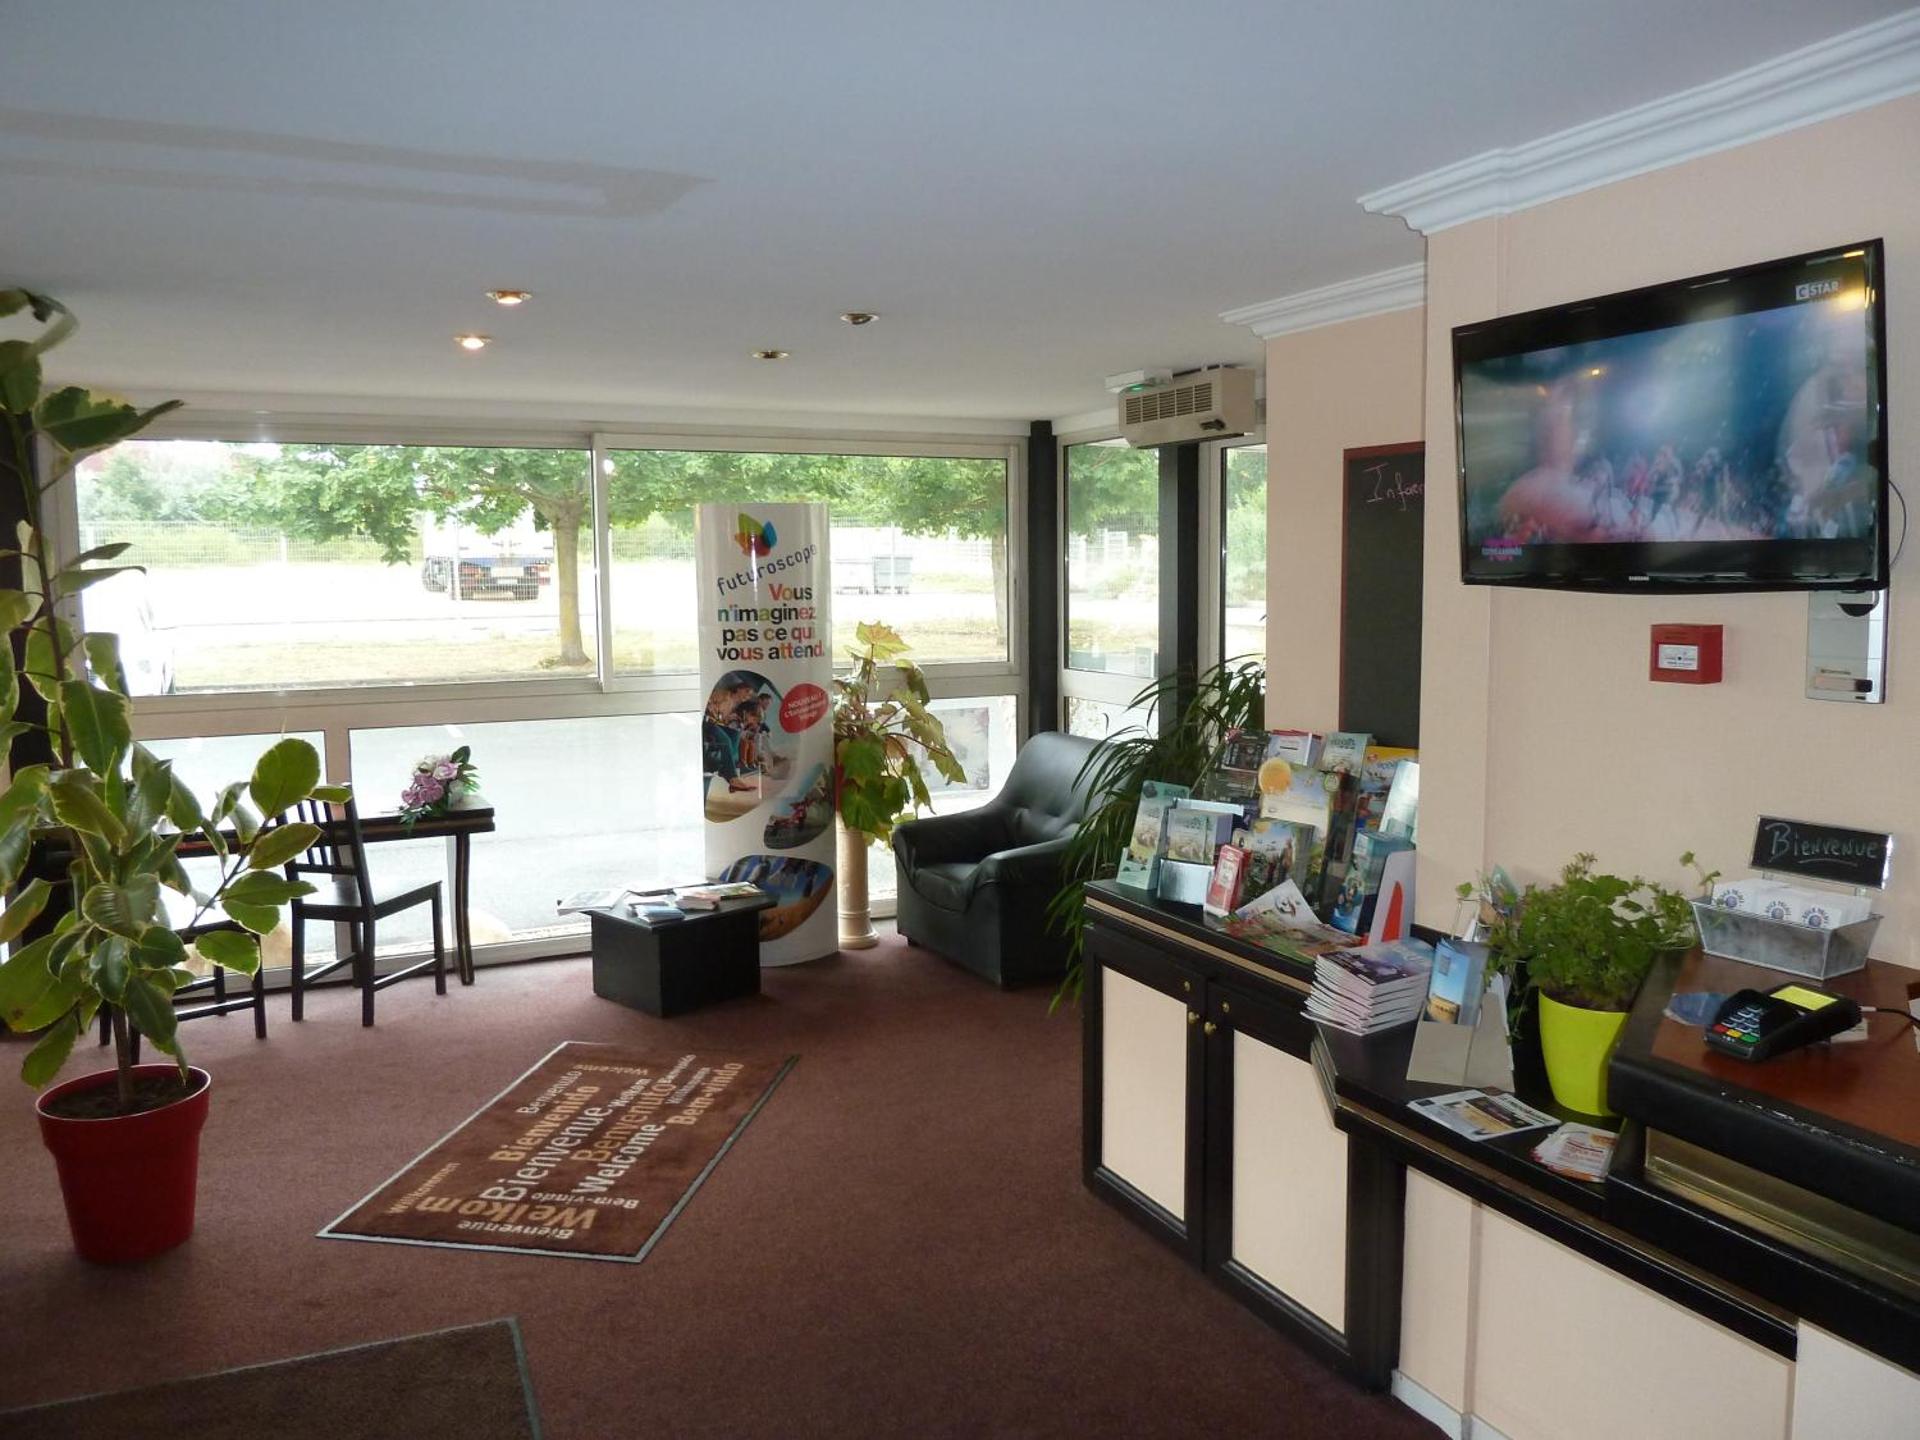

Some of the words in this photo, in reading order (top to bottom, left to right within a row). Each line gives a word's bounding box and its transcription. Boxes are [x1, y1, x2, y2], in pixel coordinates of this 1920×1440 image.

[769, 583, 813, 601] Vous
[717, 604, 816, 624] n'imaginez
[716, 646, 764, 661] vous
[722, 627, 758, 645] pas
[763, 627, 787, 641] ce
[1765, 822, 1877, 863] Bienvenue
[515, 1070, 583, 1114] Benvenuto
[665, 1062, 745, 1125] Bem-vindo
[489, 1085, 600, 1161] Bienvenido
[570, 1083, 677, 1162] Benvenuto
[479, 1106, 613, 1201] Bienvenue
[571, 1123, 667, 1193] Welcome
[415, 1196, 598, 1230] Welkom
[531, 1192, 639, 1209] Bem-vindo
[457, 1220, 575, 1240] Bienvenue
